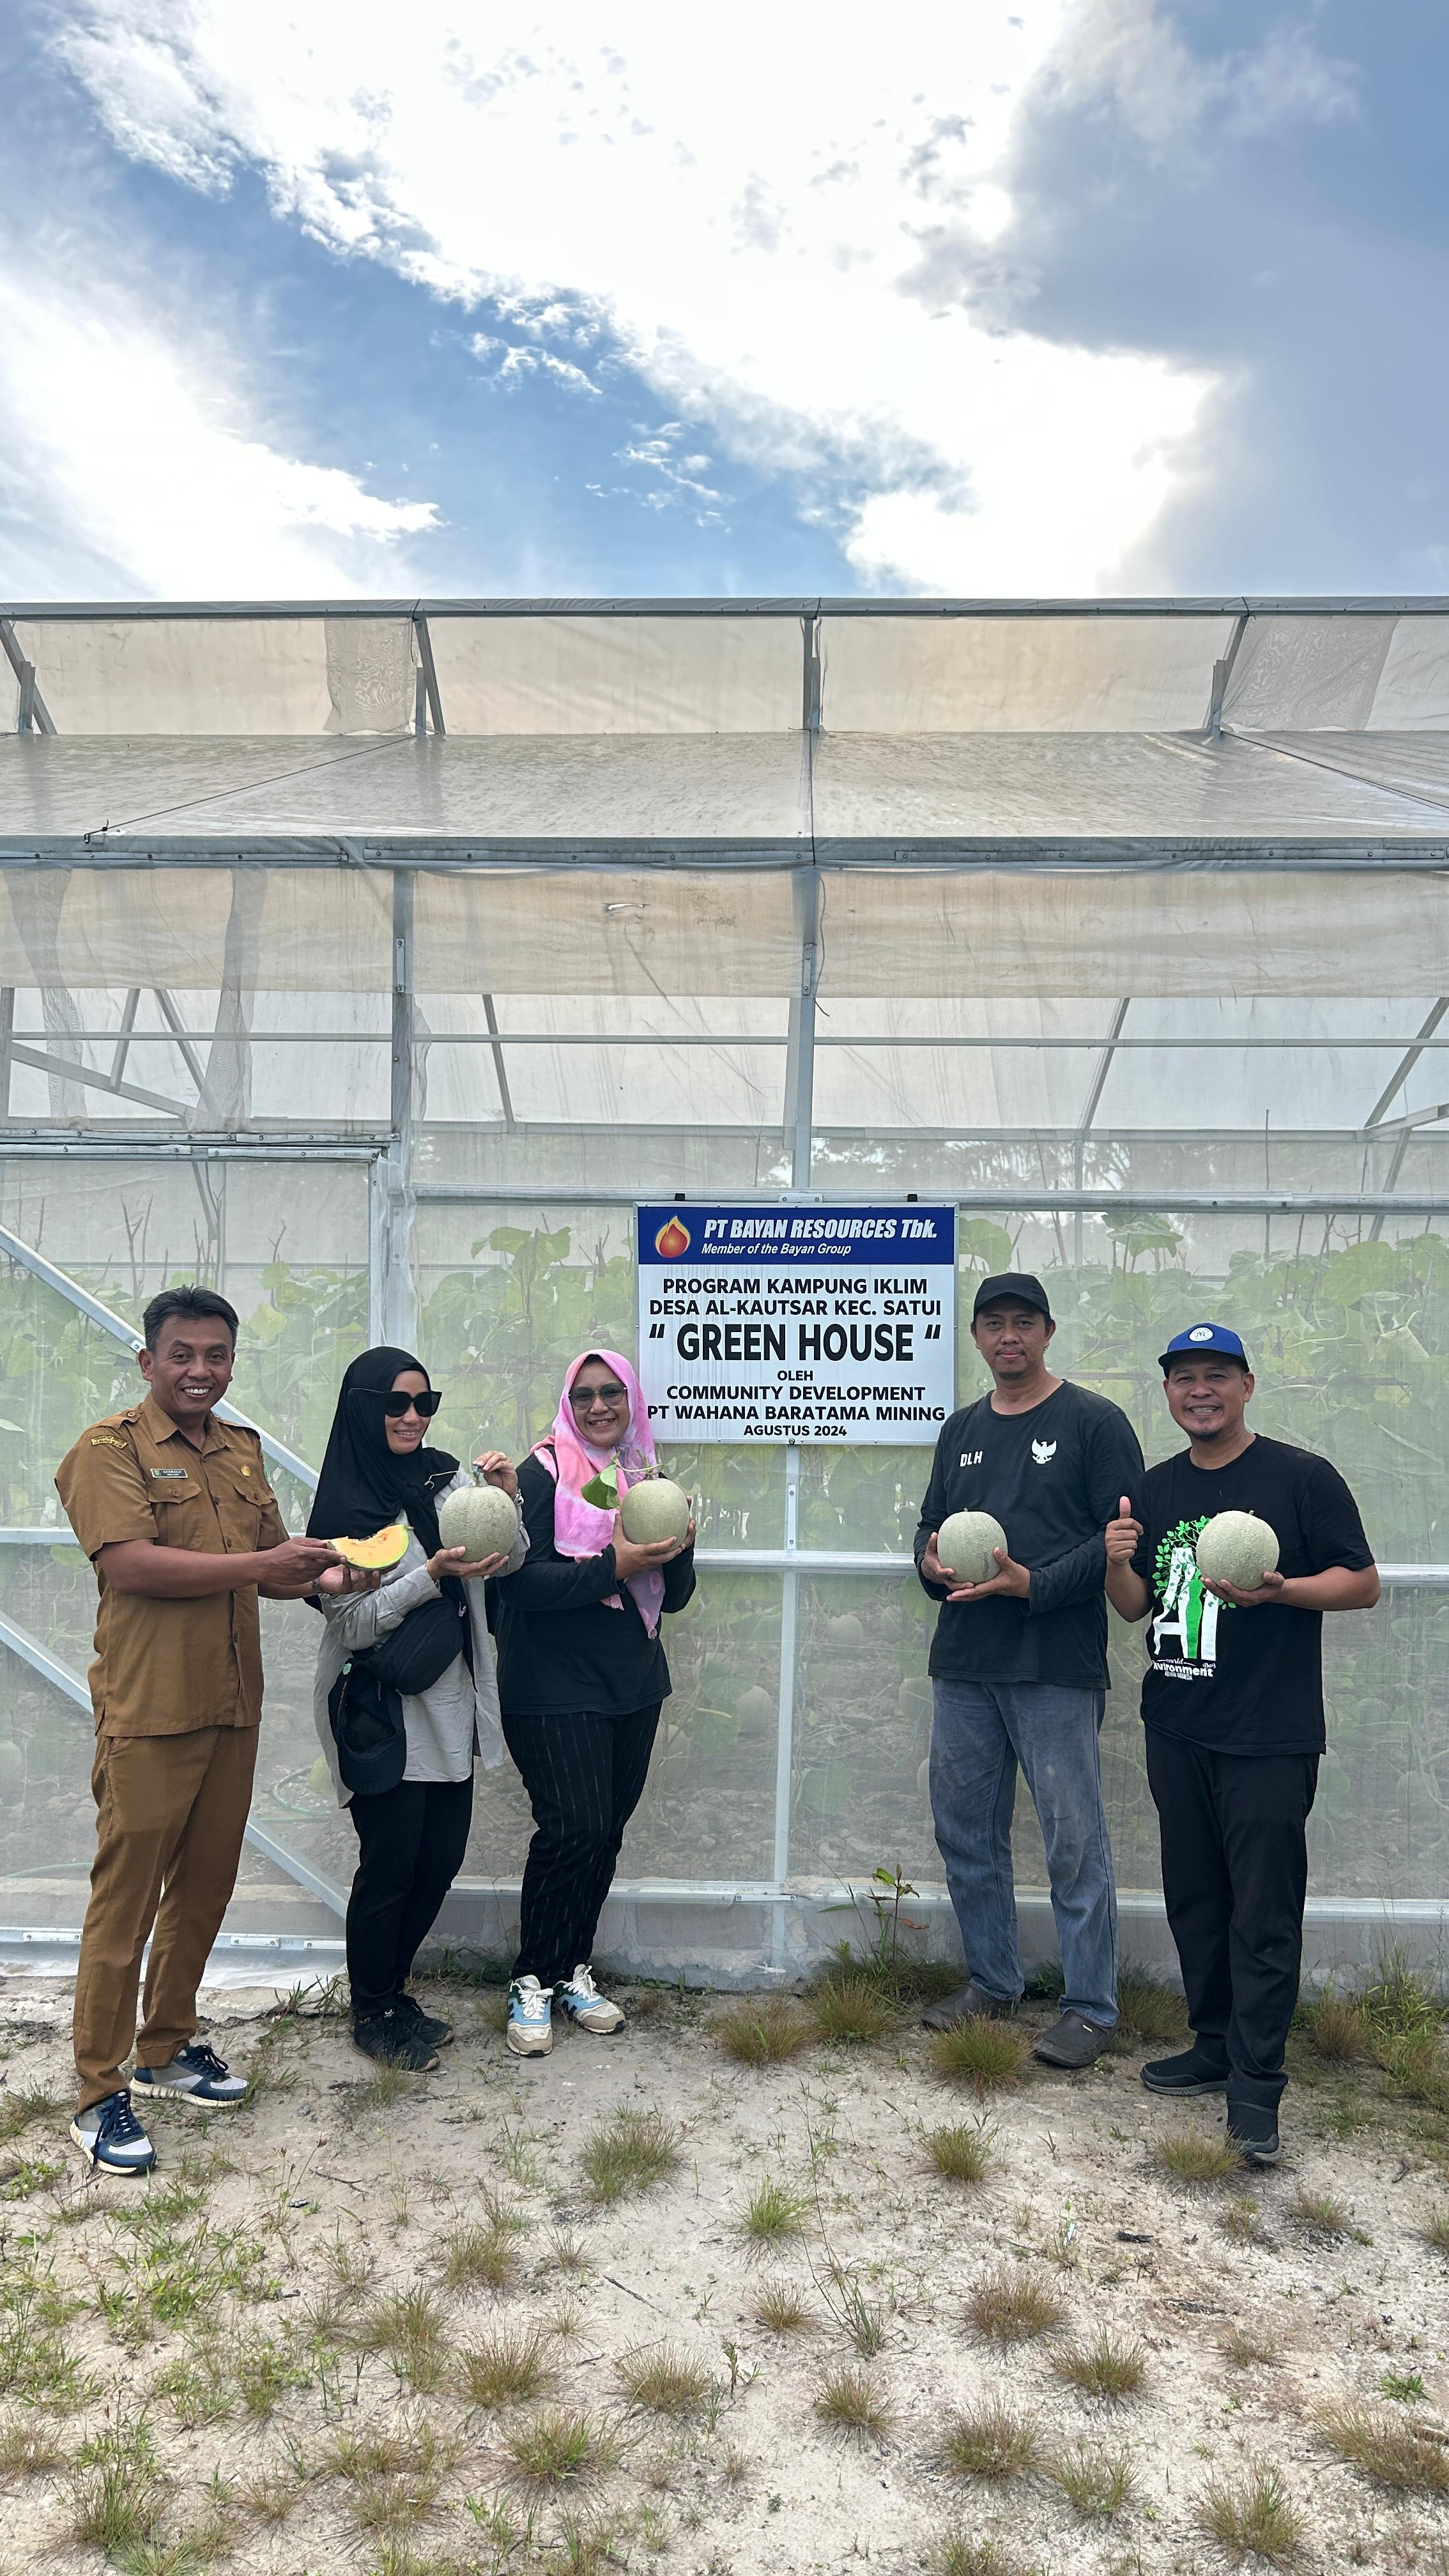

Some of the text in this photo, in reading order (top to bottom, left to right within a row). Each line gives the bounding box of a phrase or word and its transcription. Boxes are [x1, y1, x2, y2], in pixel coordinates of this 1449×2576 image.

[704, 1219, 937, 1239] PT BAYAN RESOURCES Tbk.
[702, 1243, 852, 1257] Member of the Bayan Group
[663, 1278, 927, 1294] PROGRAM KAMPUNG IKLIM
[650, 1300, 941, 1315] DESA AL-KAUTSAR KEC. SATUI
[677, 1323, 786, 1361] GREEN
[799, 1323, 914, 1361] HOUSE
[777, 1370, 813, 1381] OLEH
[666, 1386, 926, 1401] COMMUNITY DEVELOPMENT
[647, 1405, 946, 1421] PT WAHANA BARATAMA MINING
[743, 1425, 847, 1436] AGUSTUS 2024
[960, 1450, 983, 1467] DLH
